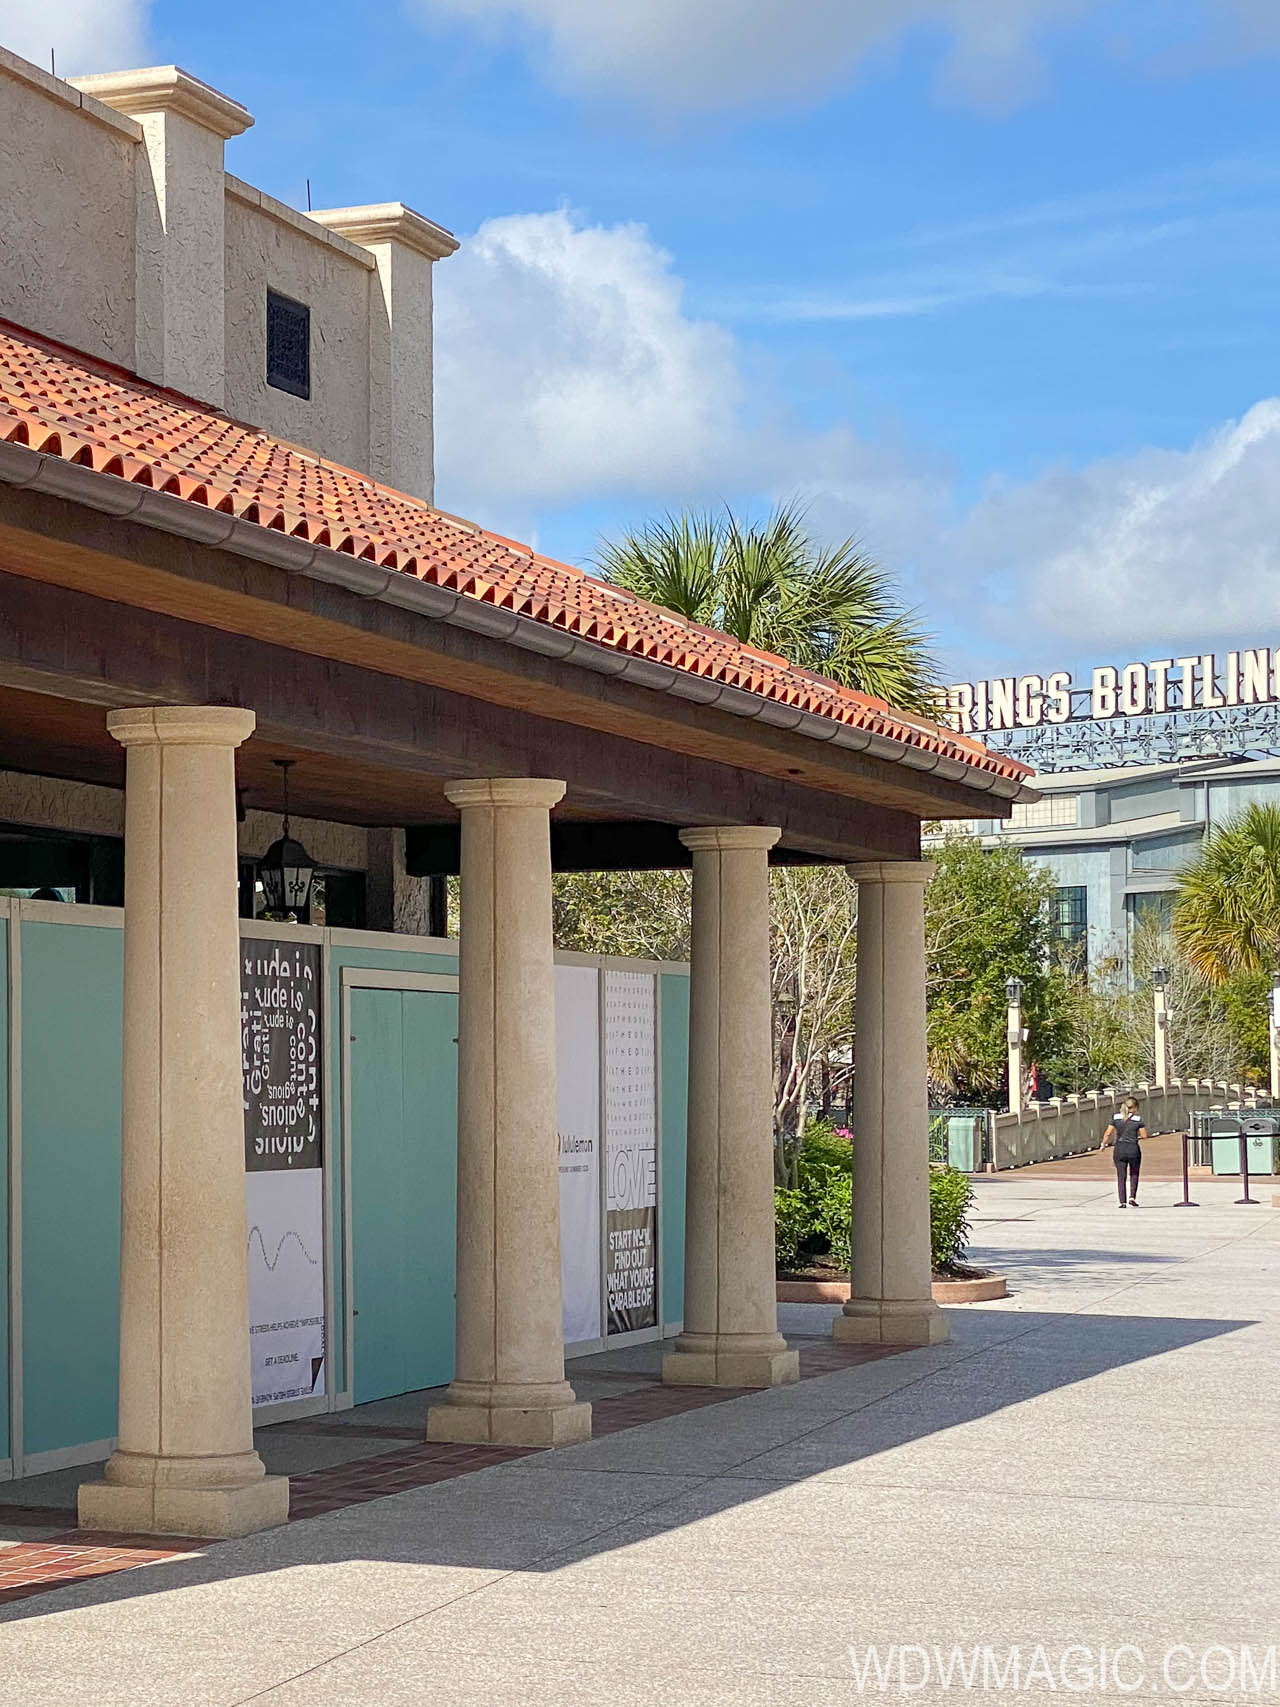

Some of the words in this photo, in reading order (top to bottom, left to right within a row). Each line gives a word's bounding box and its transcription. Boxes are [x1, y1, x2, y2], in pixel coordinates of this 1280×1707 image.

[932, 671, 1072, 734] RINGS
[1093, 648, 1280, 720] BOTTLIN
[609, 1230, 632, 1250] START
[614, 1250, 631, 1270] FIND
[631, 1248, 648, 1268] OUT
[607, 1270, 629, 1291] WHAT
